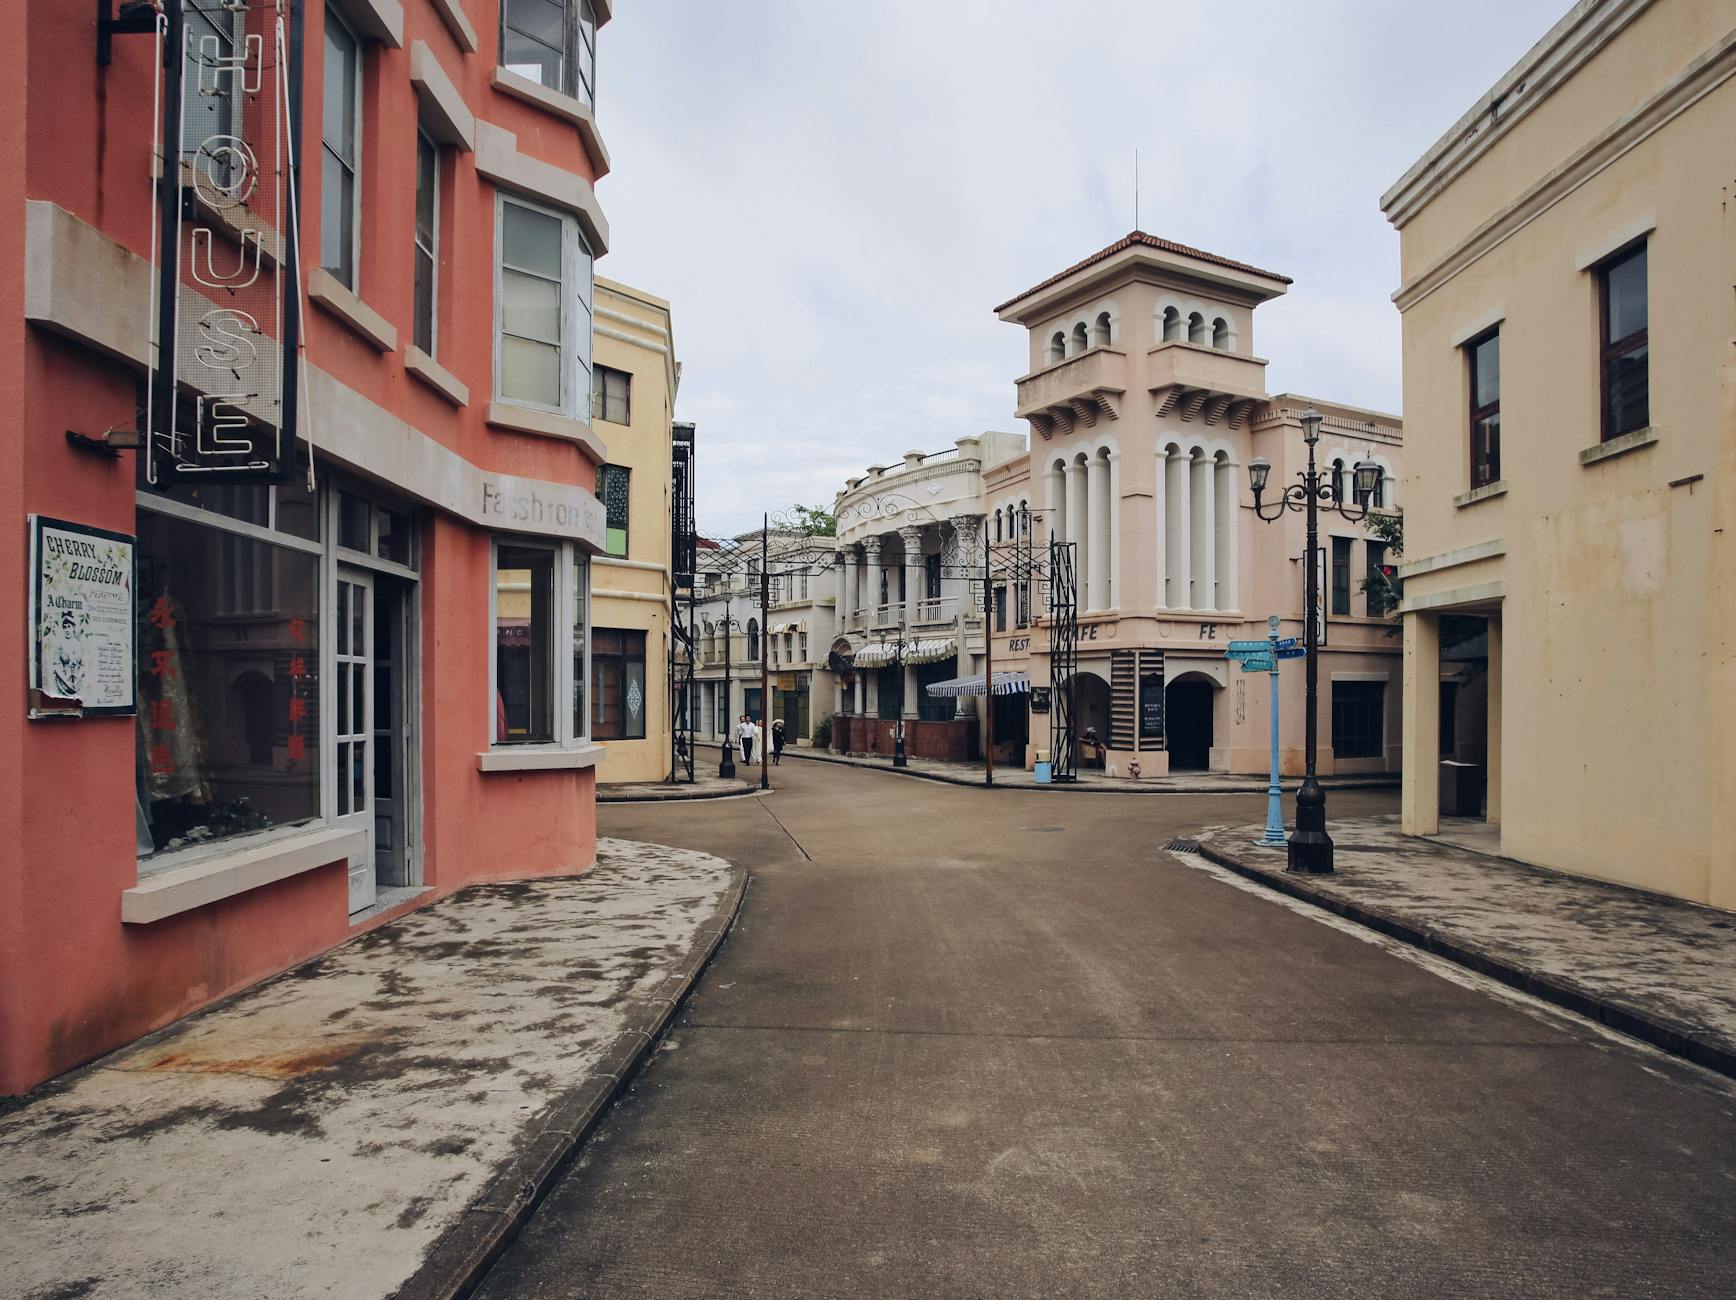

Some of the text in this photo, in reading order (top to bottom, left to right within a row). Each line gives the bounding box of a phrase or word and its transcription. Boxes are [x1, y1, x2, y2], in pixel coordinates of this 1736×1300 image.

[192, 34, 263, 456] HOUSE
[46, 535, 96, 560] CHERRY
[69, 562, 123, 586] BLOSSOM
[47, 594, 54, 607] A
[55, 595, 83, 610] Charm
[1199, 623, 1217, 640] FE
[1009, 637, 1031, 652] REST
